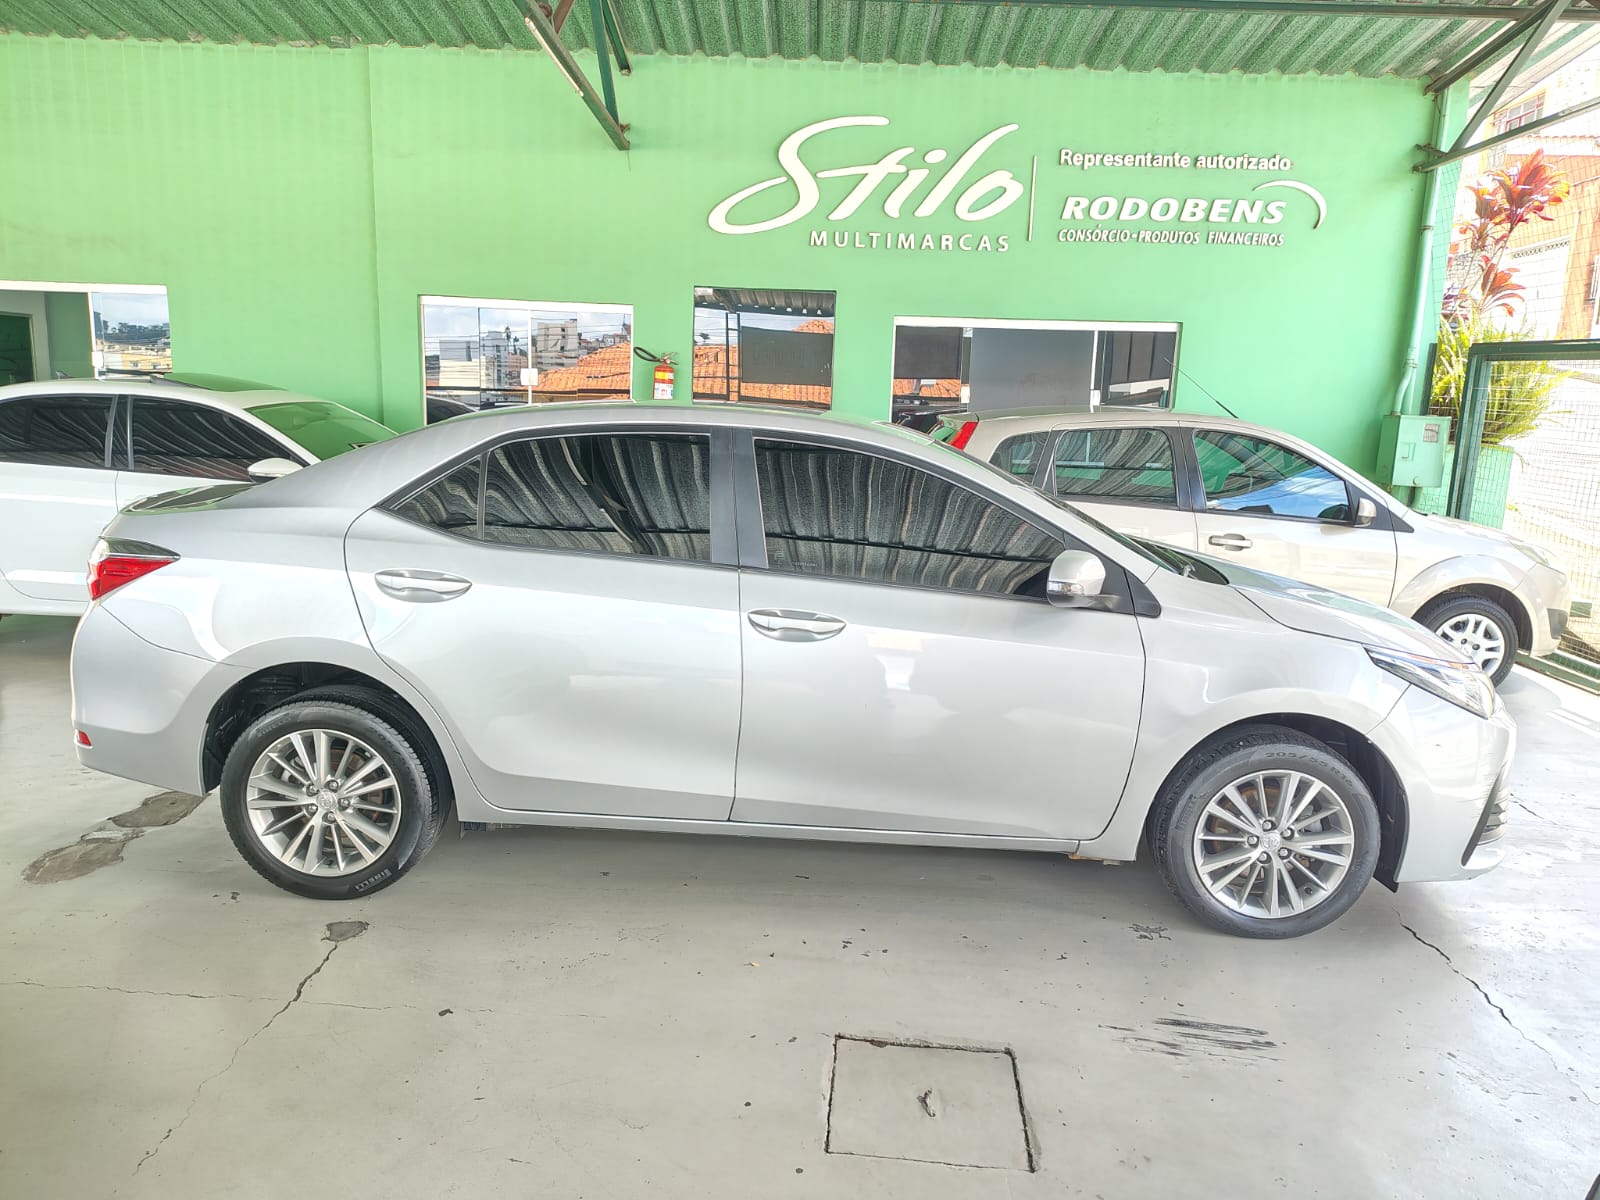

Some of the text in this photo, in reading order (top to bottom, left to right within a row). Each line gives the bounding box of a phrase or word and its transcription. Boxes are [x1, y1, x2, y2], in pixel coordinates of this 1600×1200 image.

[1059, 149, 1291, 171] Representante autorizado
[708, 115, 1025, 236] Stilo
[1060, 196, 1287, 225] RODOBENS
[809, 229, 1010, 253] MULTIMARCAS
[1207, 231, 1285, 247] FINANCEIROS
